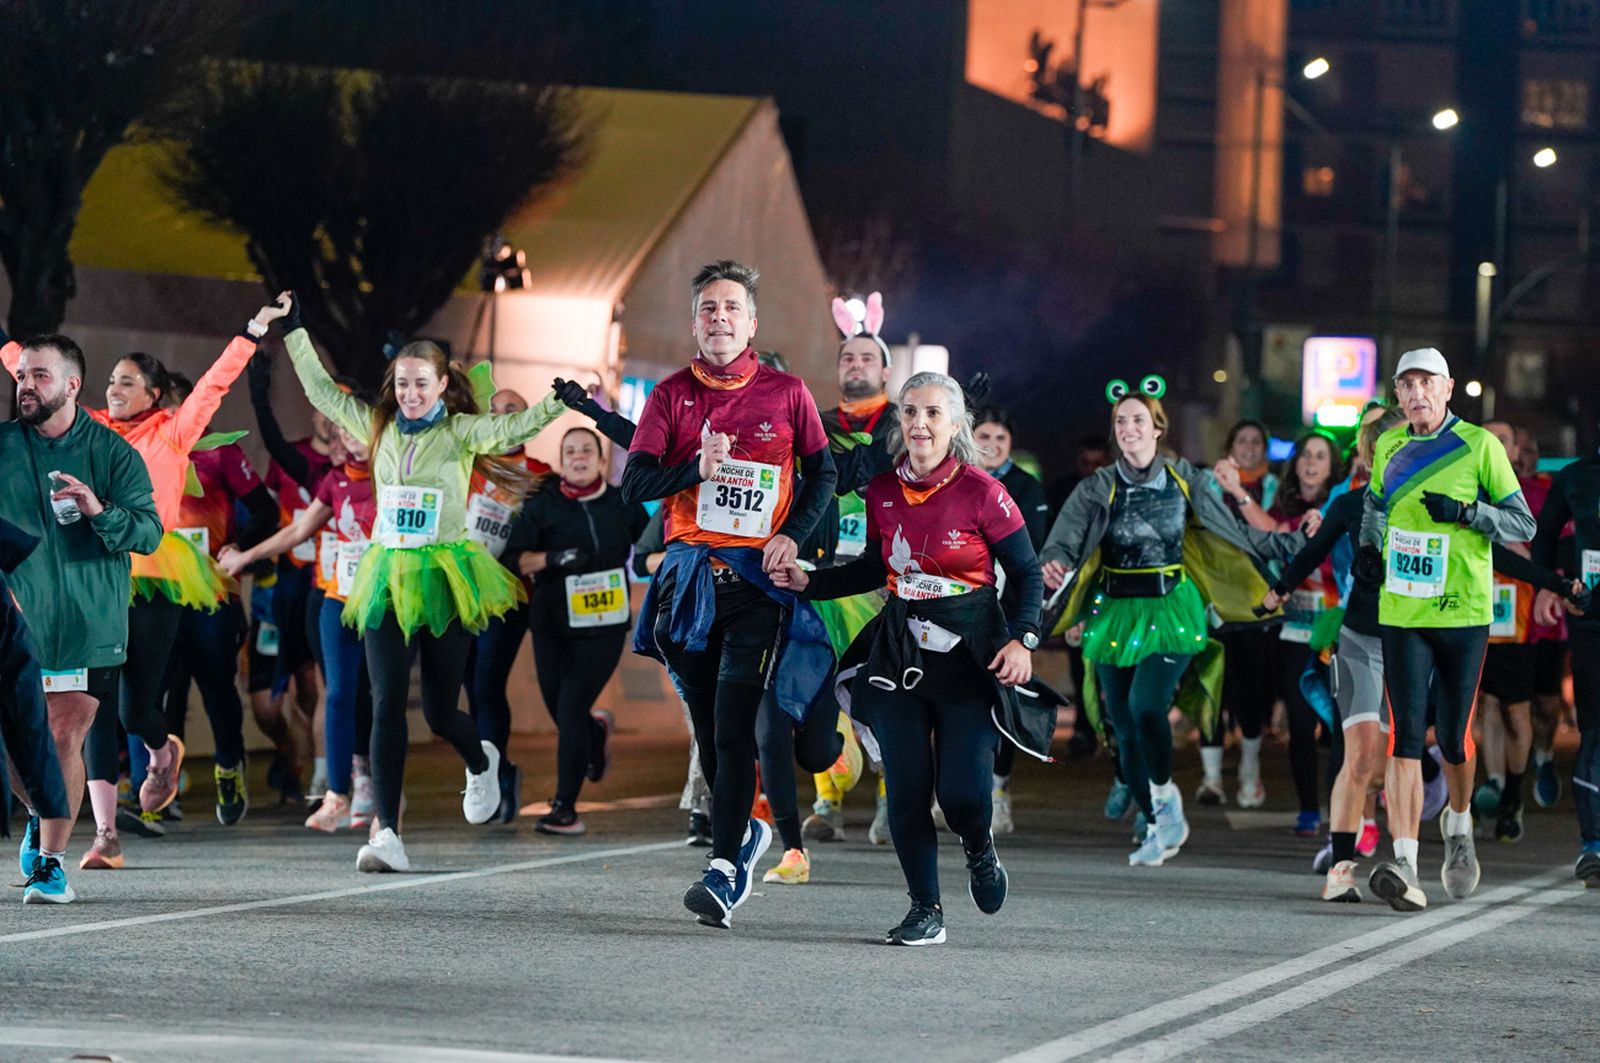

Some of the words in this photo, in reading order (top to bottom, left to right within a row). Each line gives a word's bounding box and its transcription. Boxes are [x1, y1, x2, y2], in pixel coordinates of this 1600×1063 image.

[720, 466, 744, 476] NOCHE
[745, 470, 755, 478] DE
[716, 485, 764, 512] 3512
[476, 517, 512, 539] 1086
[839, 519, 859, 536] 42
[1397, 553, 1433, 576] 9246
[933, 584, 944, 592] DE
[583, 591, 614, 608] 1347
